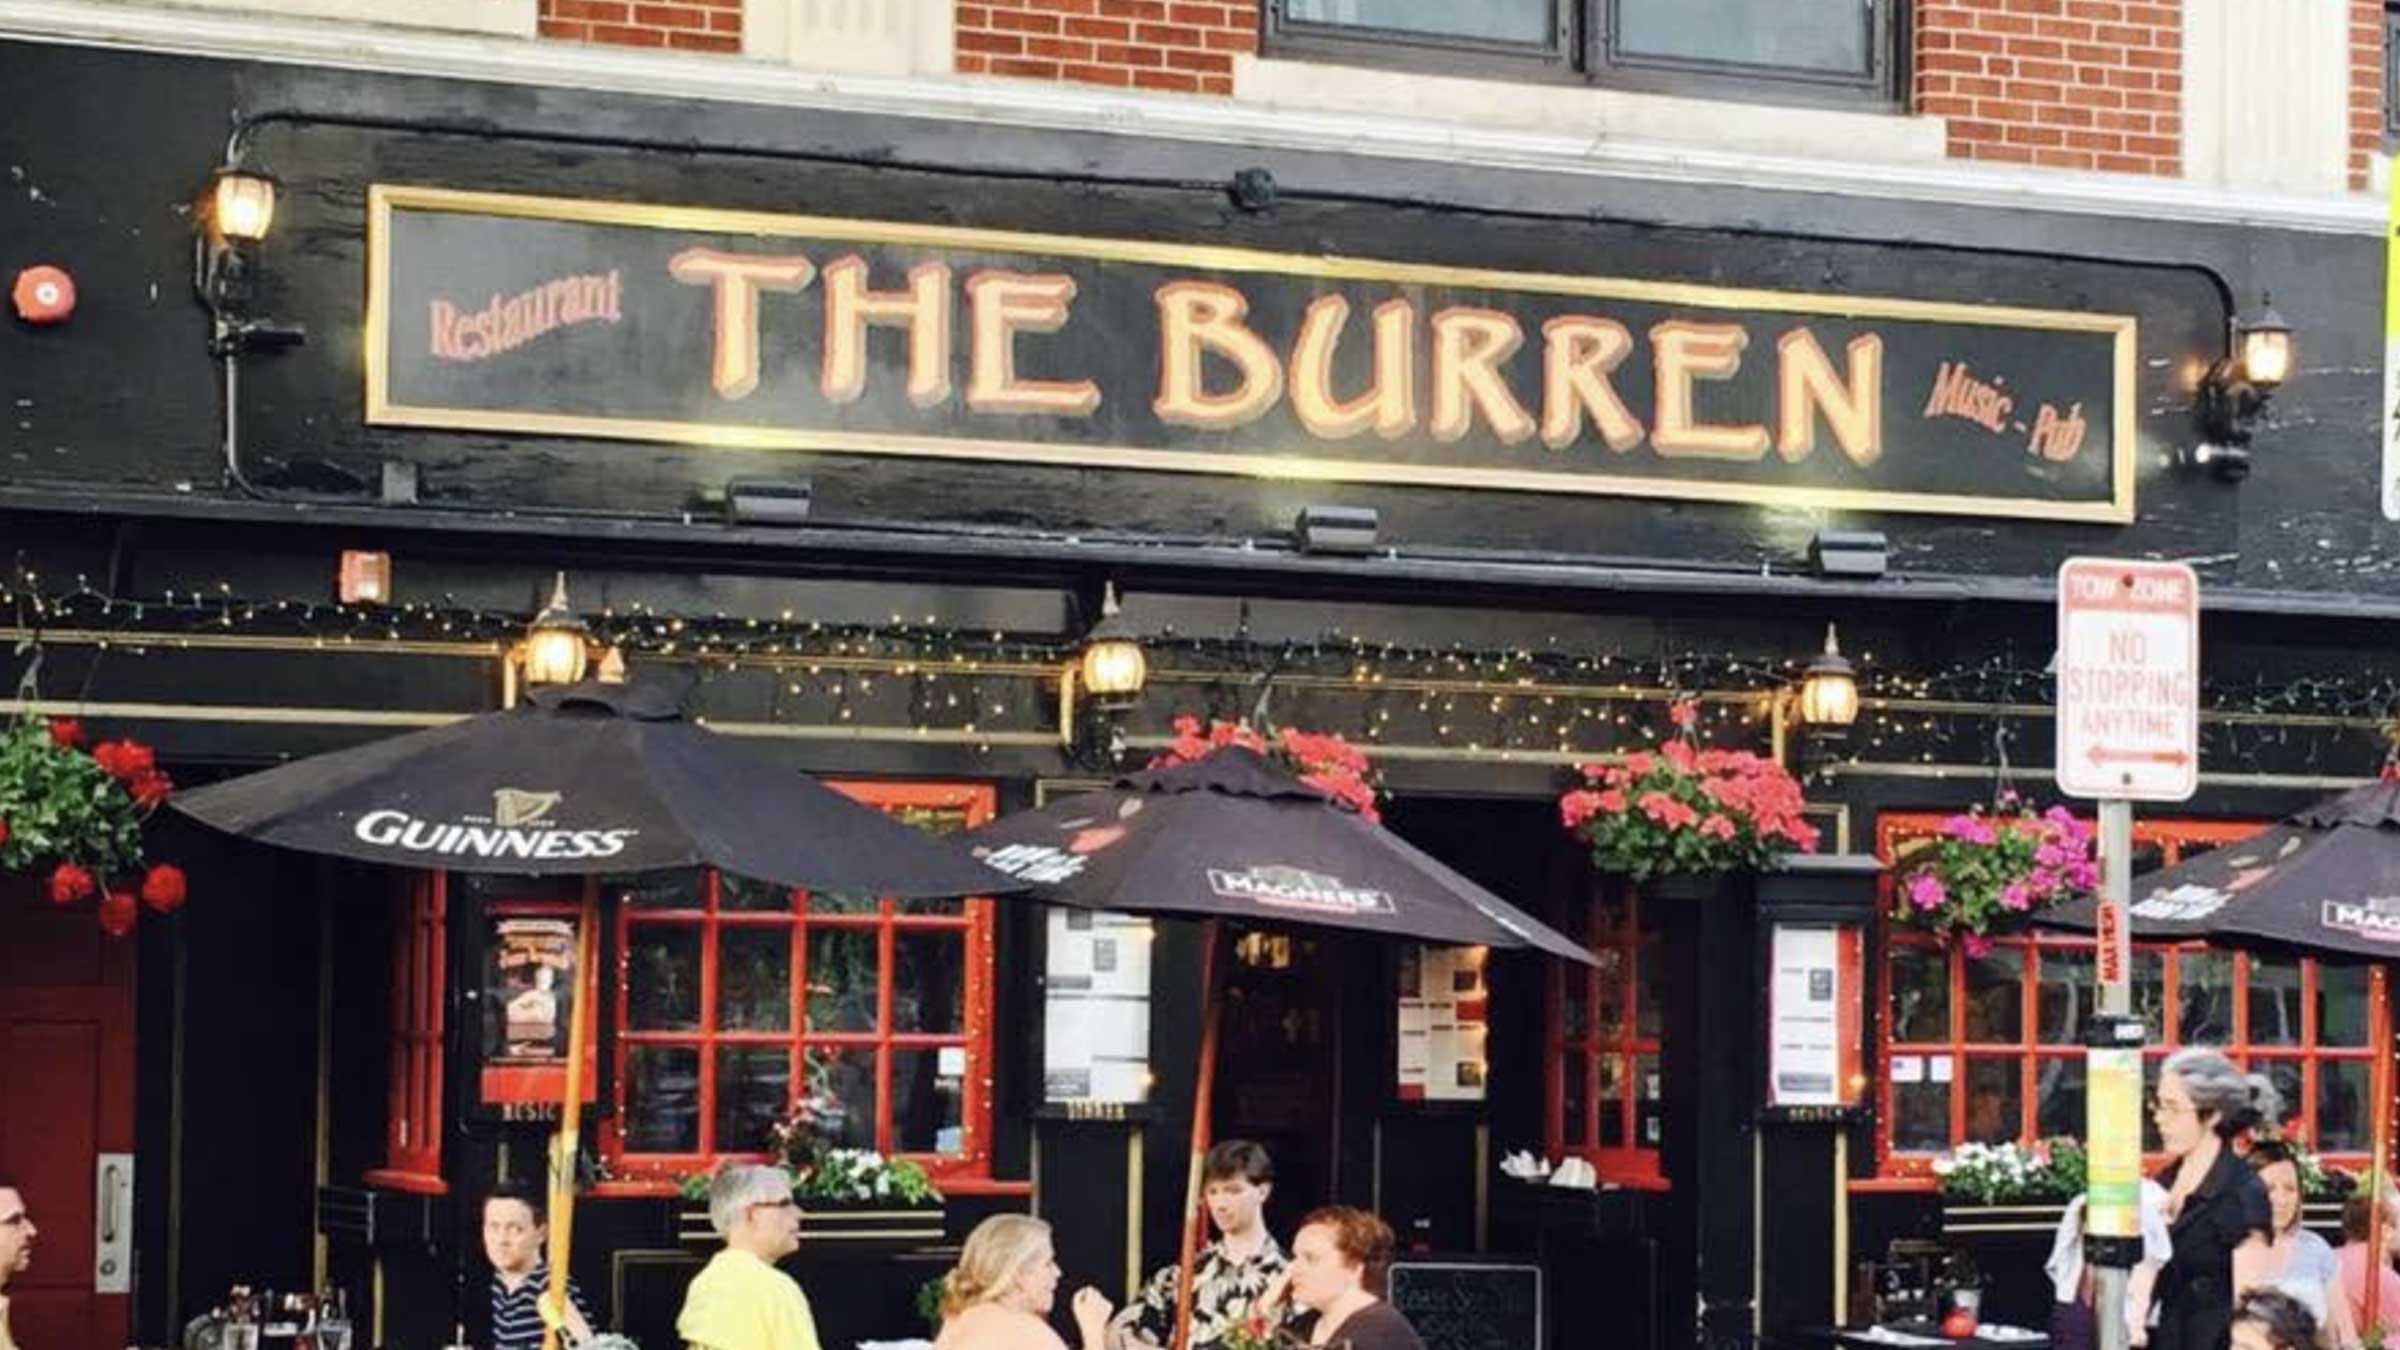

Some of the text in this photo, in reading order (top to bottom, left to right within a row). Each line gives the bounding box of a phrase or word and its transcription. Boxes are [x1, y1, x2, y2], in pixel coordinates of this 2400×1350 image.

[430, 269, 624, 363] Restaurant
[669, 246, 1883, 466] THE BURREN
[1924, 361, 2013, 434] Music
[2027, 401, 2087, 462] Pub
[2070, 574, 2187, 605] TOW ZONE
[2108, 632, 2146, 666] NO
[2068, 668, 2190, 706] STOPPING
[2080, 707, 2177, 739] ANYTIME
[355, 809, 637, 859] GUINNESS
[1222, 874, 1377, 907] MAGNERS
